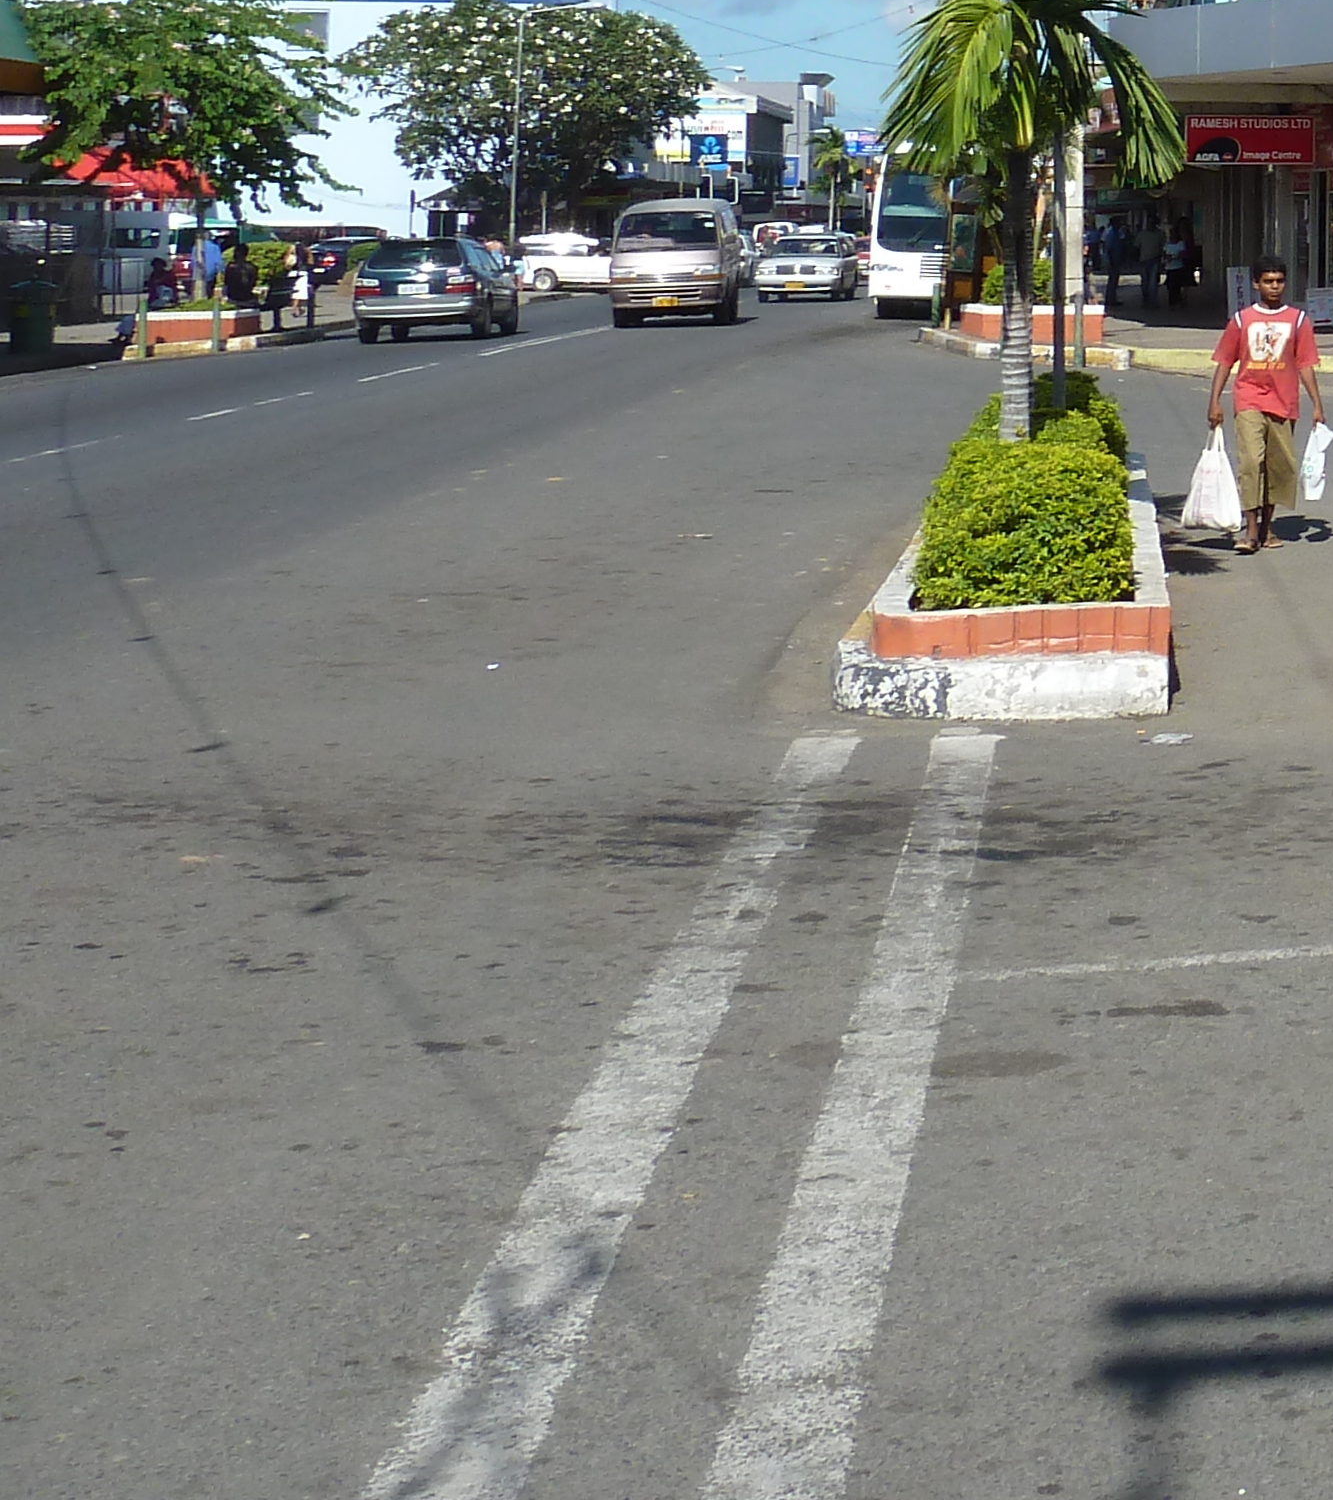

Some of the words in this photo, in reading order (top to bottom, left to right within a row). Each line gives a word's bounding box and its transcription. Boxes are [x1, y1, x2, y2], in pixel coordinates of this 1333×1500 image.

[1190, 118, 1238, 129] RAMESH
[1240, 119, 1288, 129] STUDIOS
[1291, 119, 1311, 129] LTD
[1195, 153, 1220, 161] AGFA
